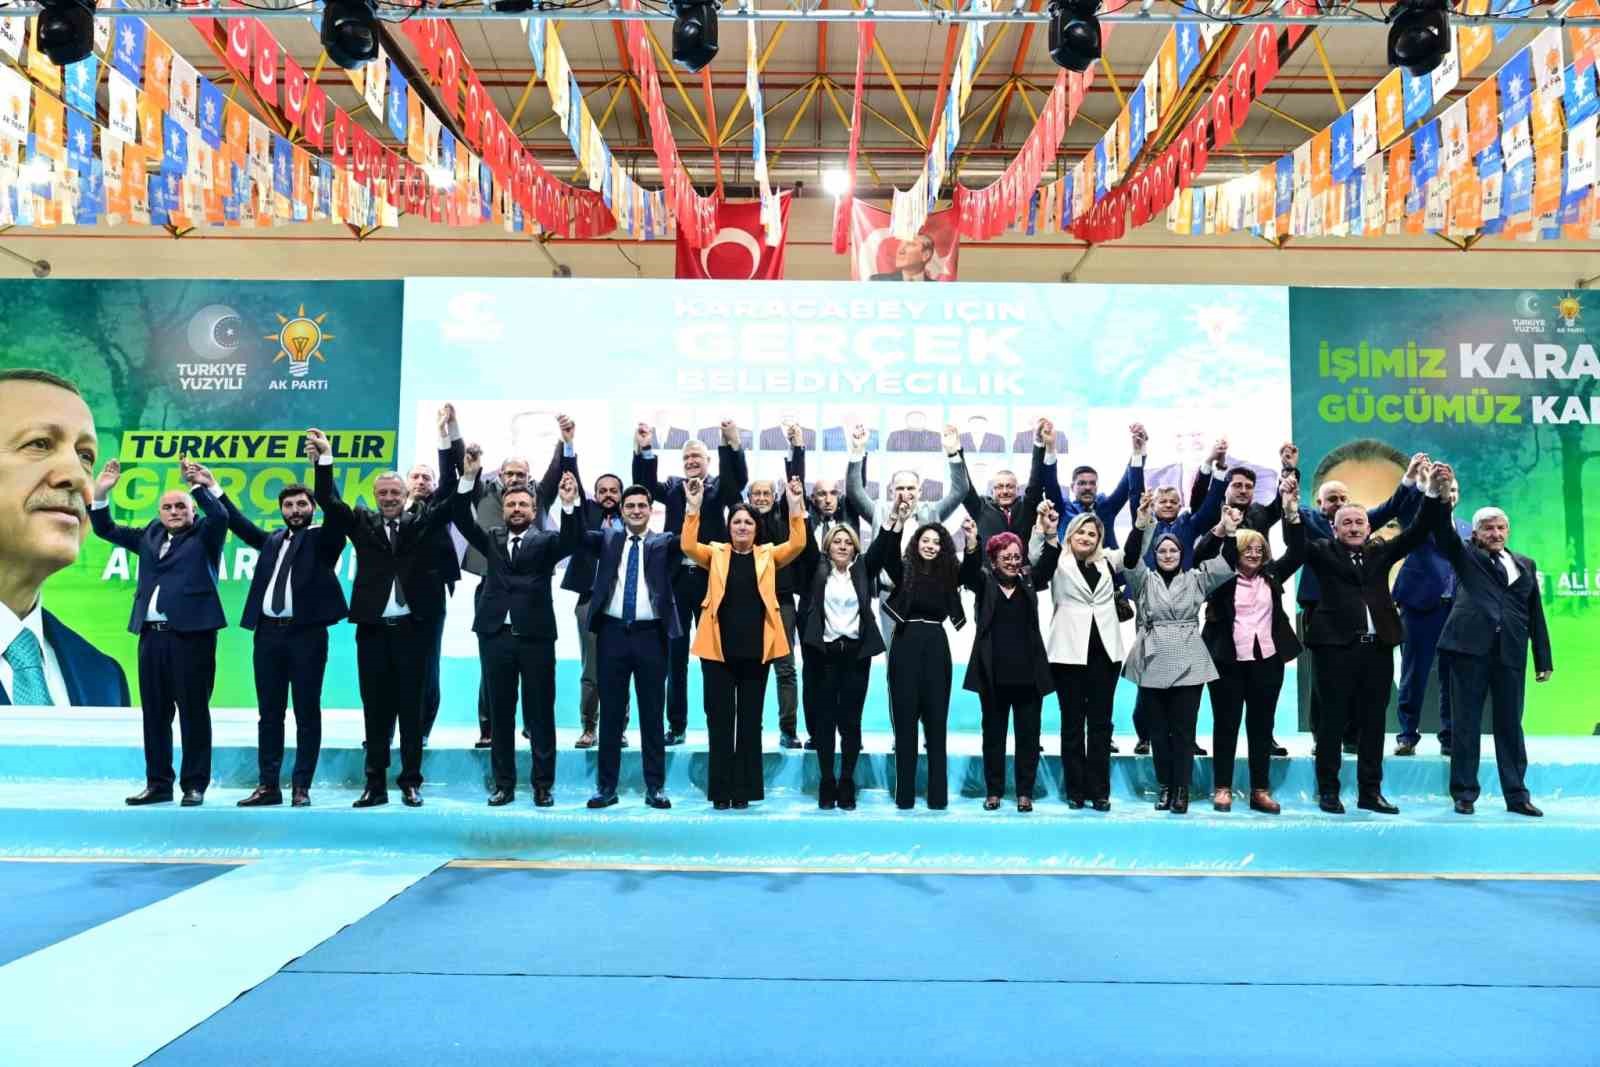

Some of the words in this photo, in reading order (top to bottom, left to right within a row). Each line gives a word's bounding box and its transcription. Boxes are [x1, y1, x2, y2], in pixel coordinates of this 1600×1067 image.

[676, 325, 1025, 375] GERÇEK
[1319, 340, 1448, 383] İŞİMİZ
[268, 380, 288, 390] AK
[1318, 387, 1522, 424] GÜCÜMÜZ
